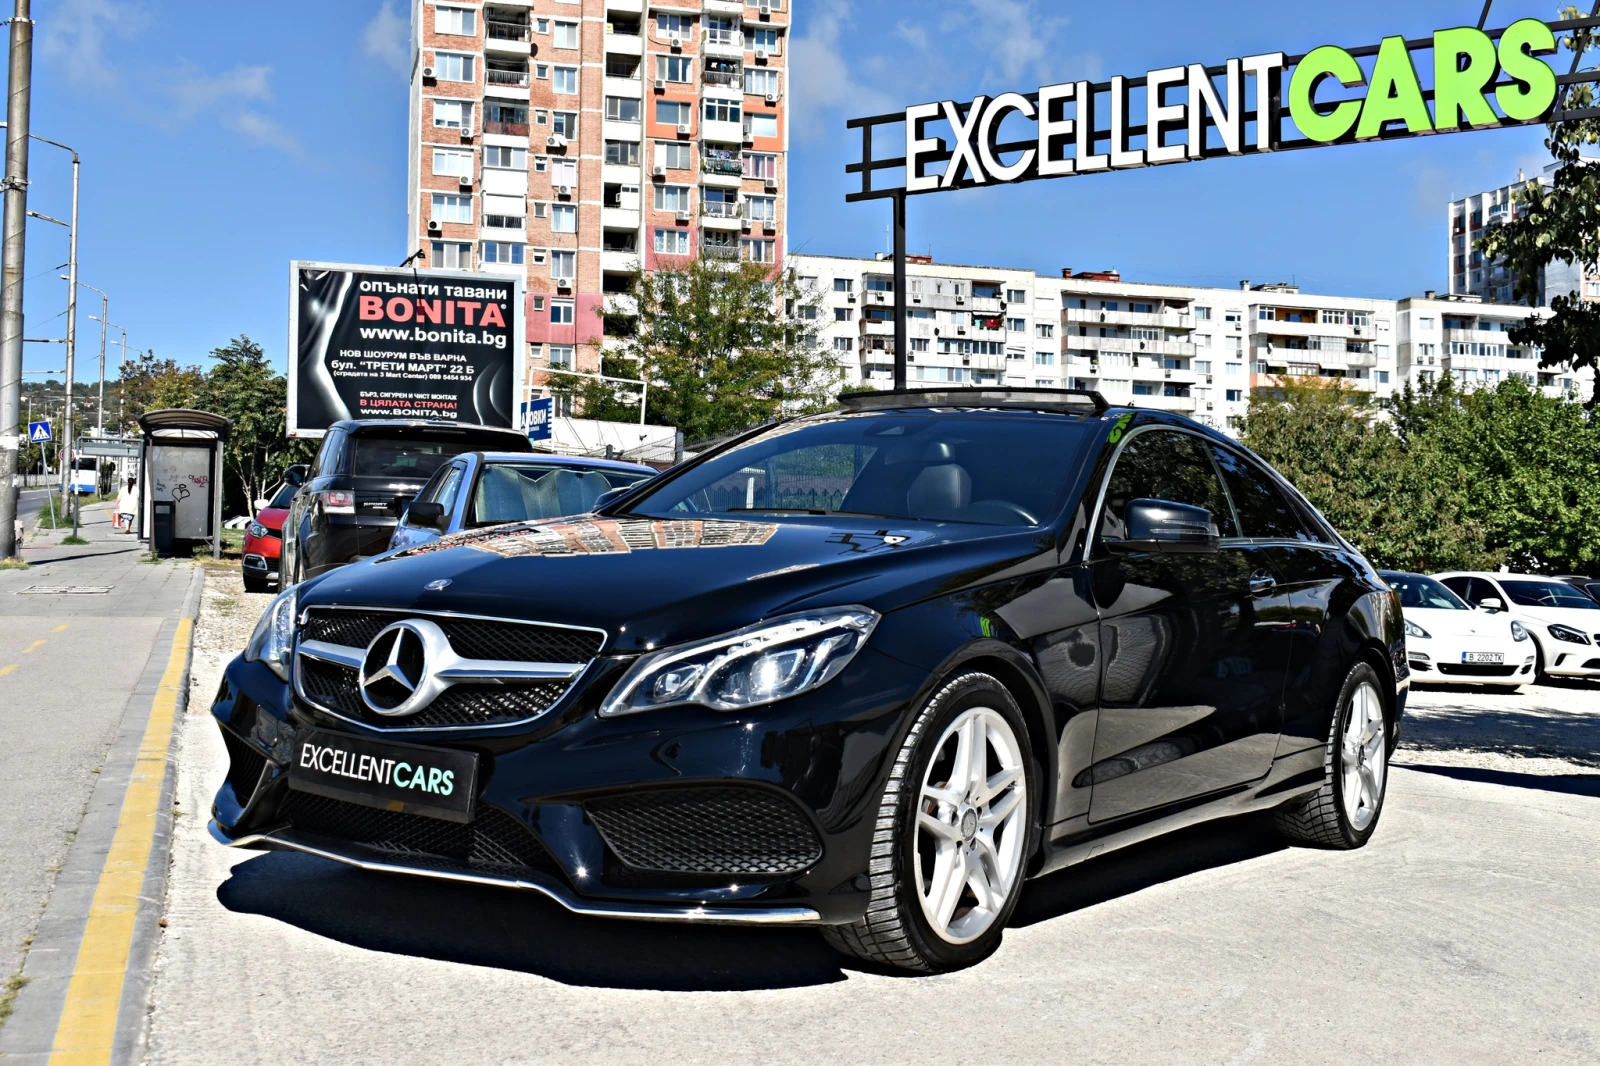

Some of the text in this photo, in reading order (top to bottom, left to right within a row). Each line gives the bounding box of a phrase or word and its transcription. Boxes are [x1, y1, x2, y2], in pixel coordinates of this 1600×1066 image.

[360, 280, 507, 300] опънати тавани
[360, 327, 506, 349] www.bonita.bg
[434, 354, 467, 362] ВАРНА
[331, 360, 356, 370] бул.
[450, 366, 465, 374] 22
[466, 366, 474, 374] Б
[414, 401, 457, 409] СТРАНА!
[360, 408, 458, 419] www.BONITA.bg
